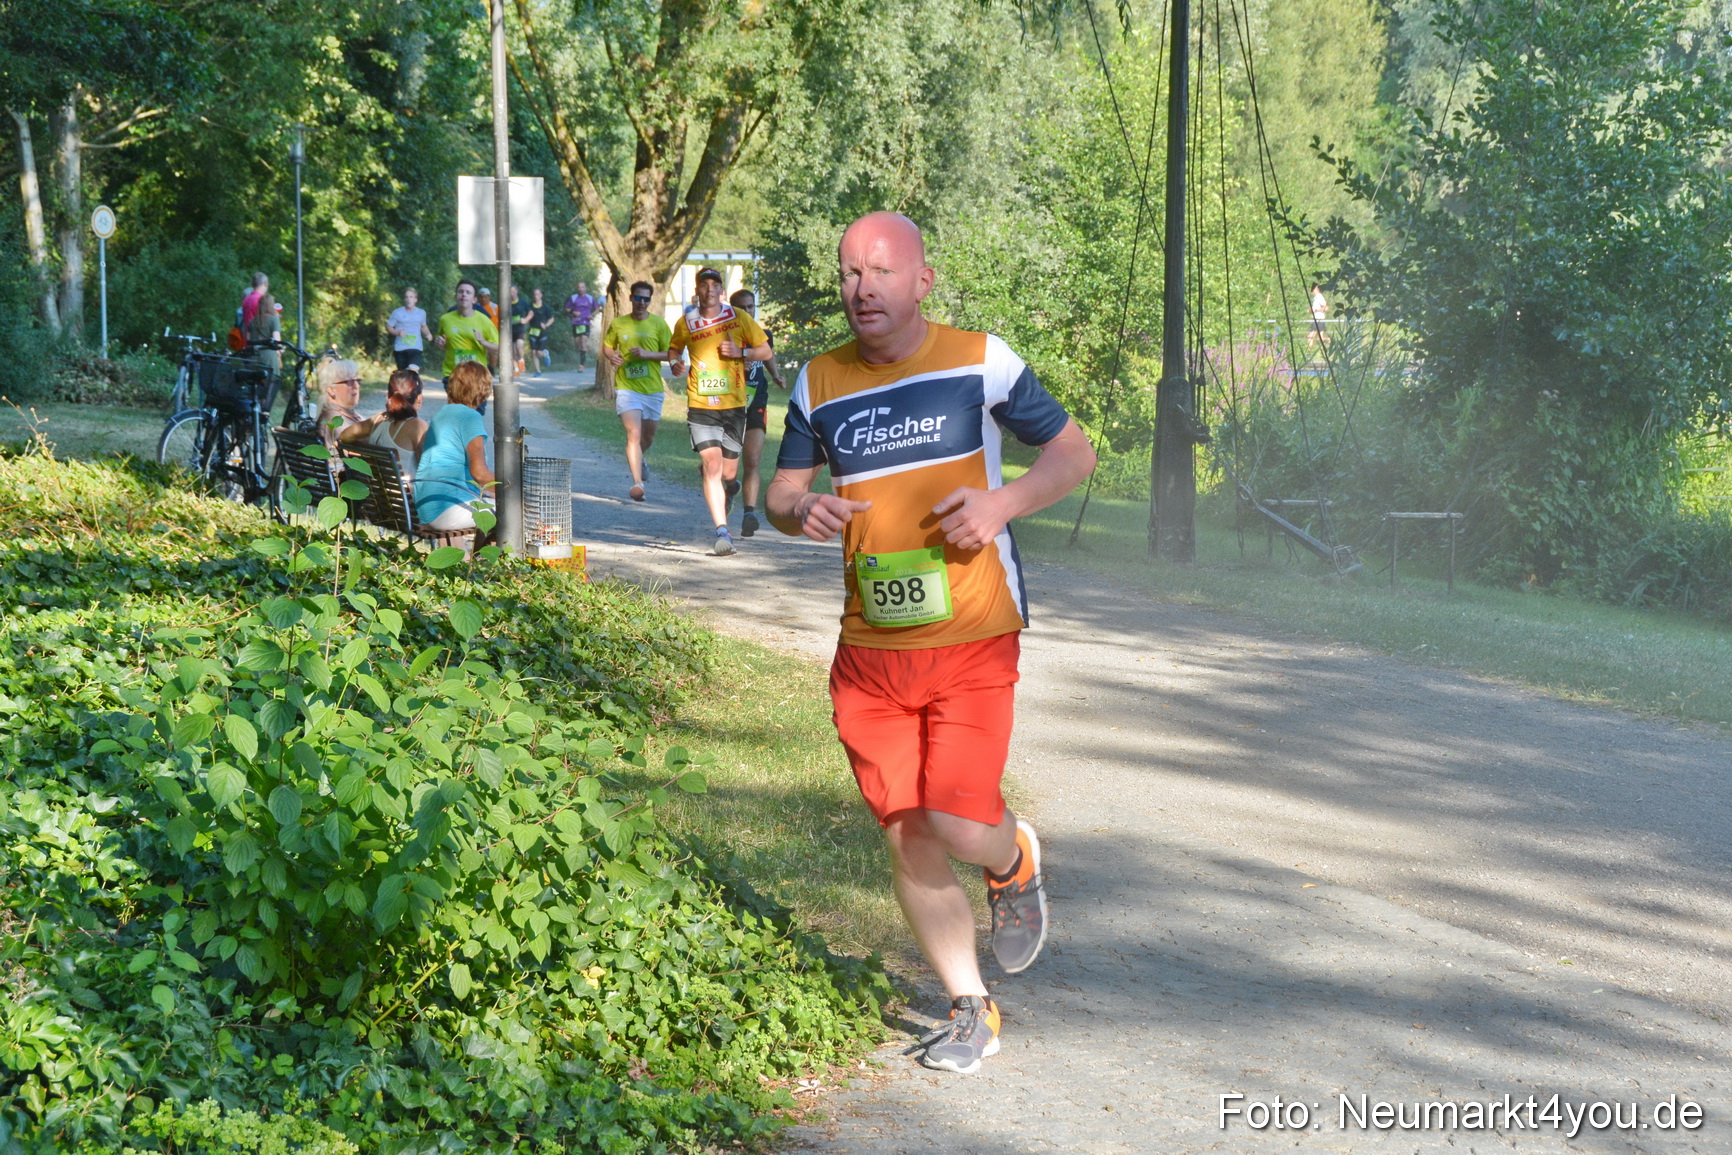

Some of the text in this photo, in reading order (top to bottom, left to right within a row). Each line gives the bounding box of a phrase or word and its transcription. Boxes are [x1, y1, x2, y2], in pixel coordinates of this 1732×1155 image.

[691, 331, 713, 342] MAX
[701, 378, 726, 388] 1226
[852, 415, 947, 447] Fischer
[862, 433, 941, 456] AUTOMOBILE
[873, 577, 926, 607] 598
